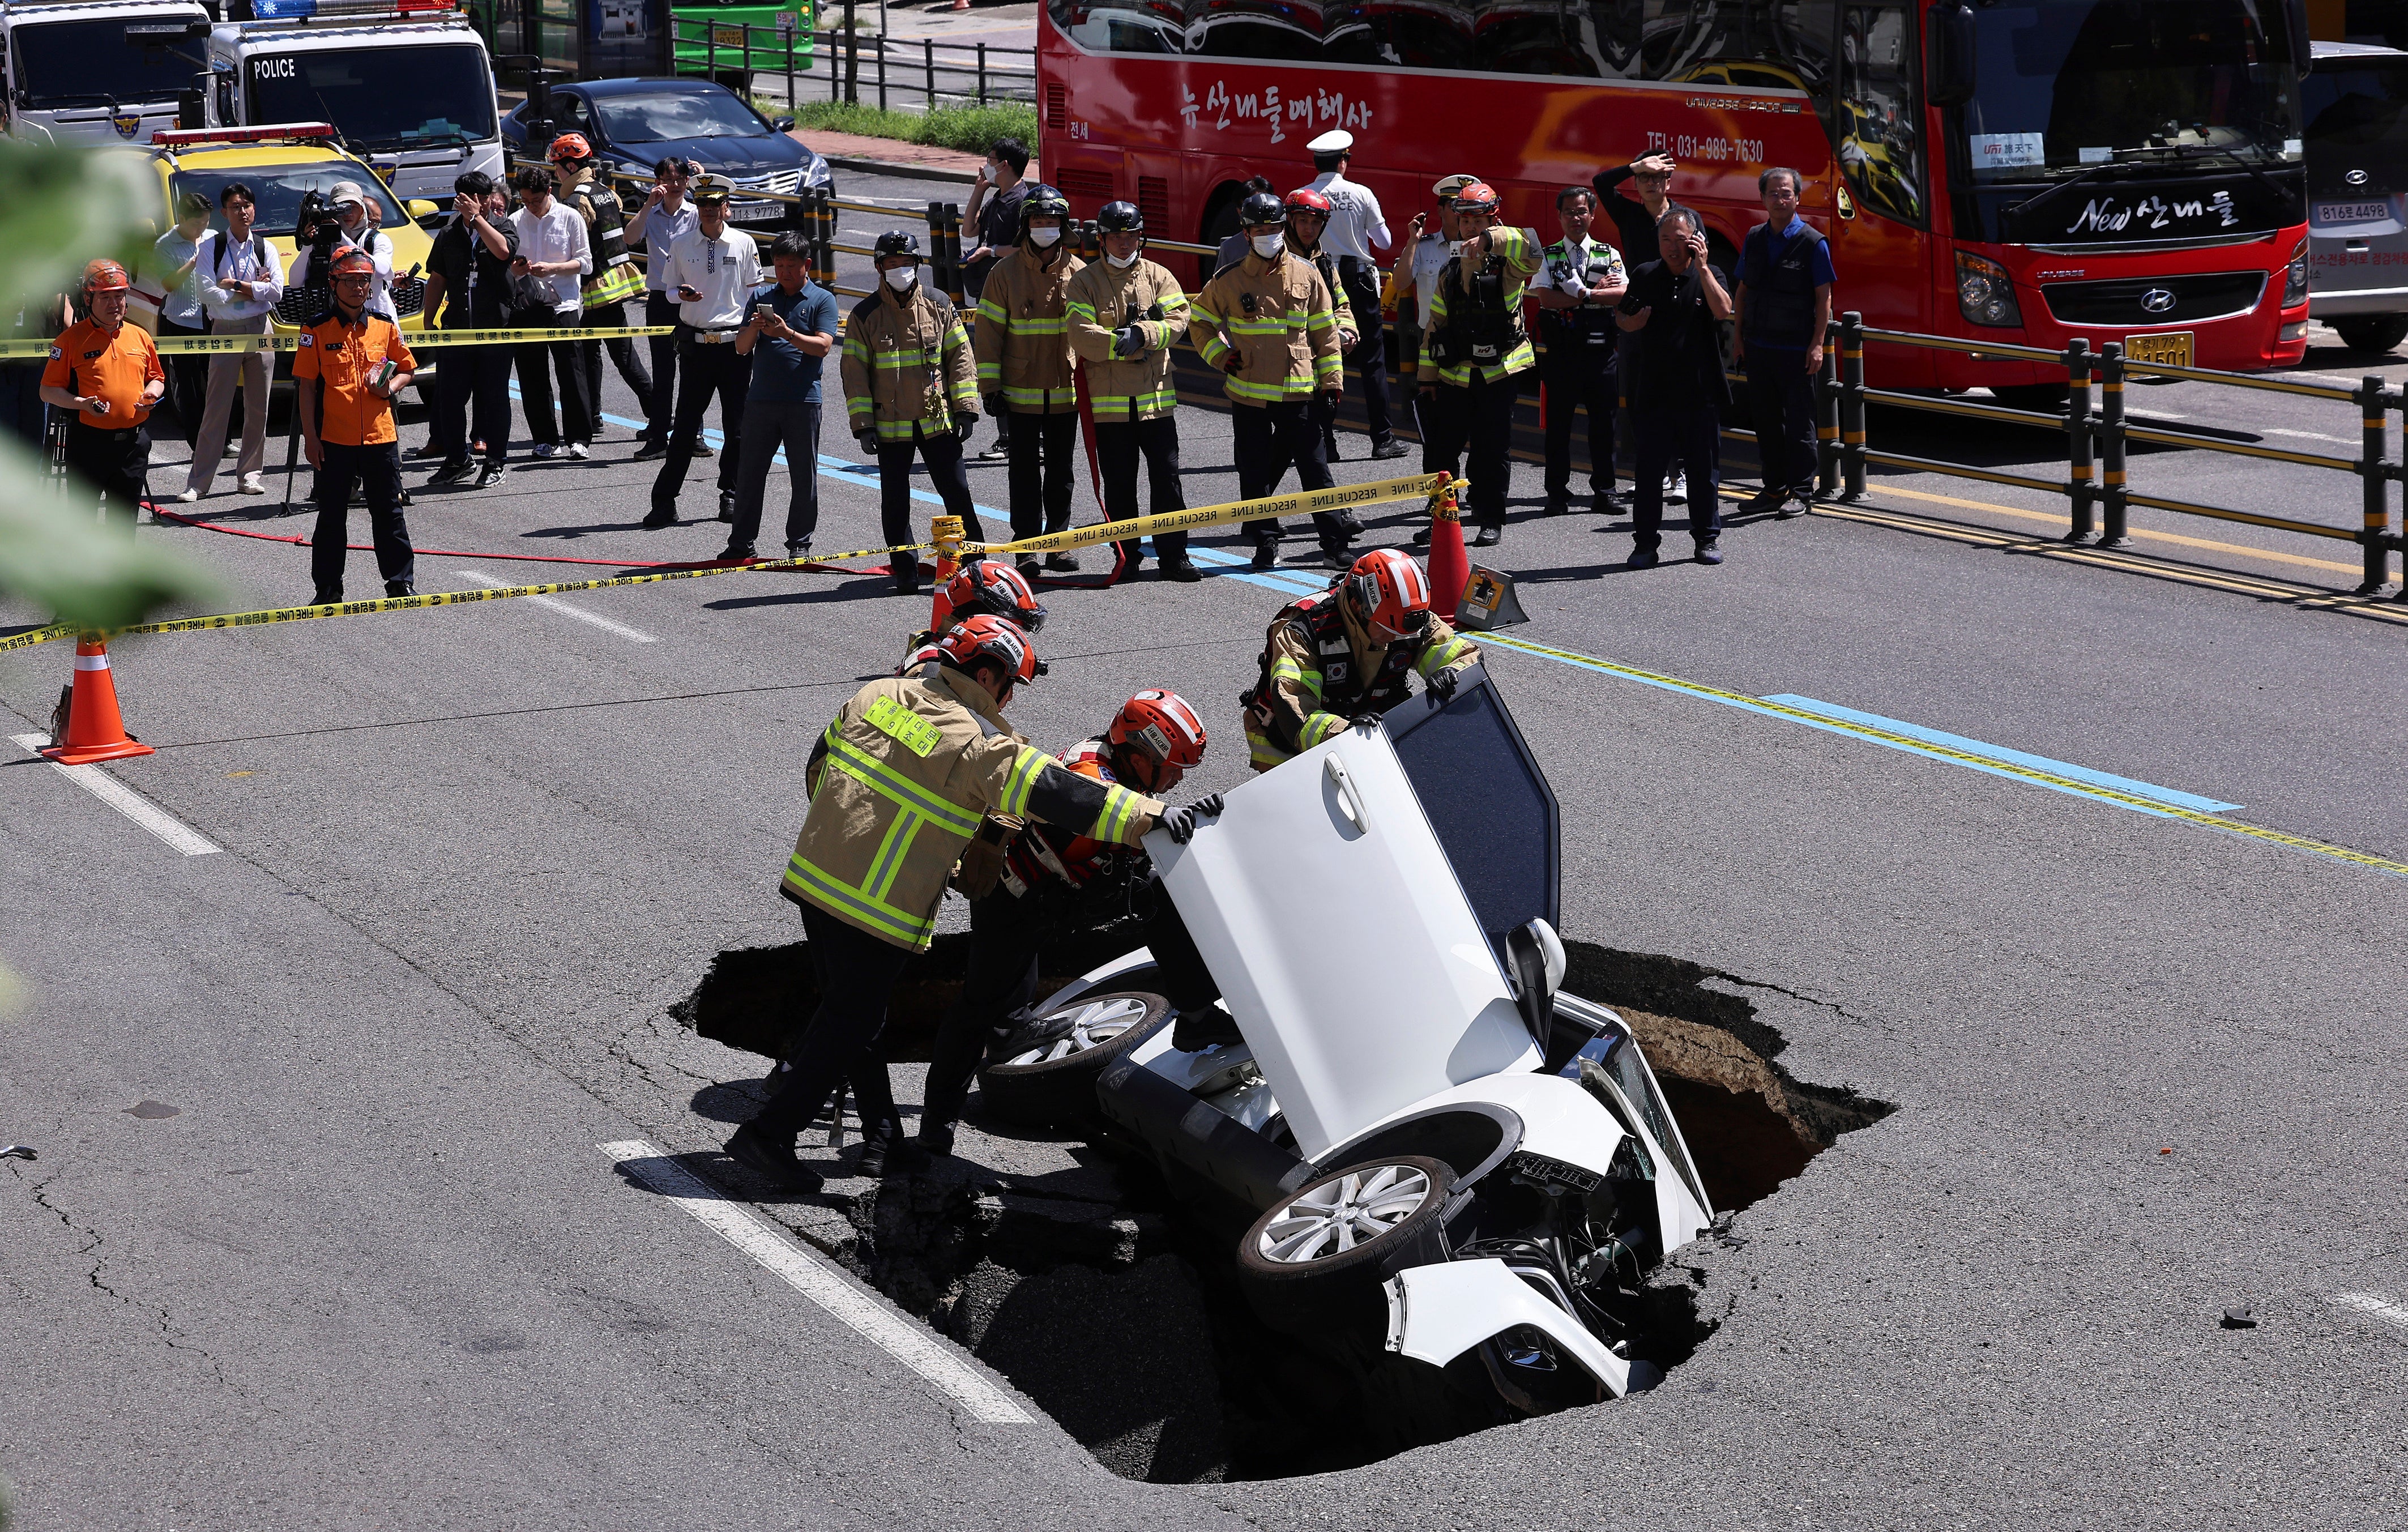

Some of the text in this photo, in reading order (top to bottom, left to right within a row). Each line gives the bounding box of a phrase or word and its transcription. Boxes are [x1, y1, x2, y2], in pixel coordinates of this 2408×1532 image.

[254, 58, 295, 79] POLICE
[1677, 135, 1764, 163] 031-989-7630
[754, 206, 780, 217] 9778
[2067, 197, 2131, 233] New
[2036, 270, 2085, 278] UNIVERSE
[2162, 337, 2176, 348] 79
[490, 589, 509, 599] LINE
[510, 587, 527, 597] FIRE
[996, 584, 1014, 603] 서울서대
[1366, 576, 1378, 605] 서울서대문
[385, 599, 403, 611] LINE
[404, 596, 421, 608] FIRE
[276, 611, 296, 621] LINE
[296, 608, 314, 619] FIRE
[167, 621, 185, 632] LINE
[187, 619, 205, 630] FIRE
[1001, 634, 1023, 659] 서울서대문
[1146, 727, 1169, 753] 서울서대문
